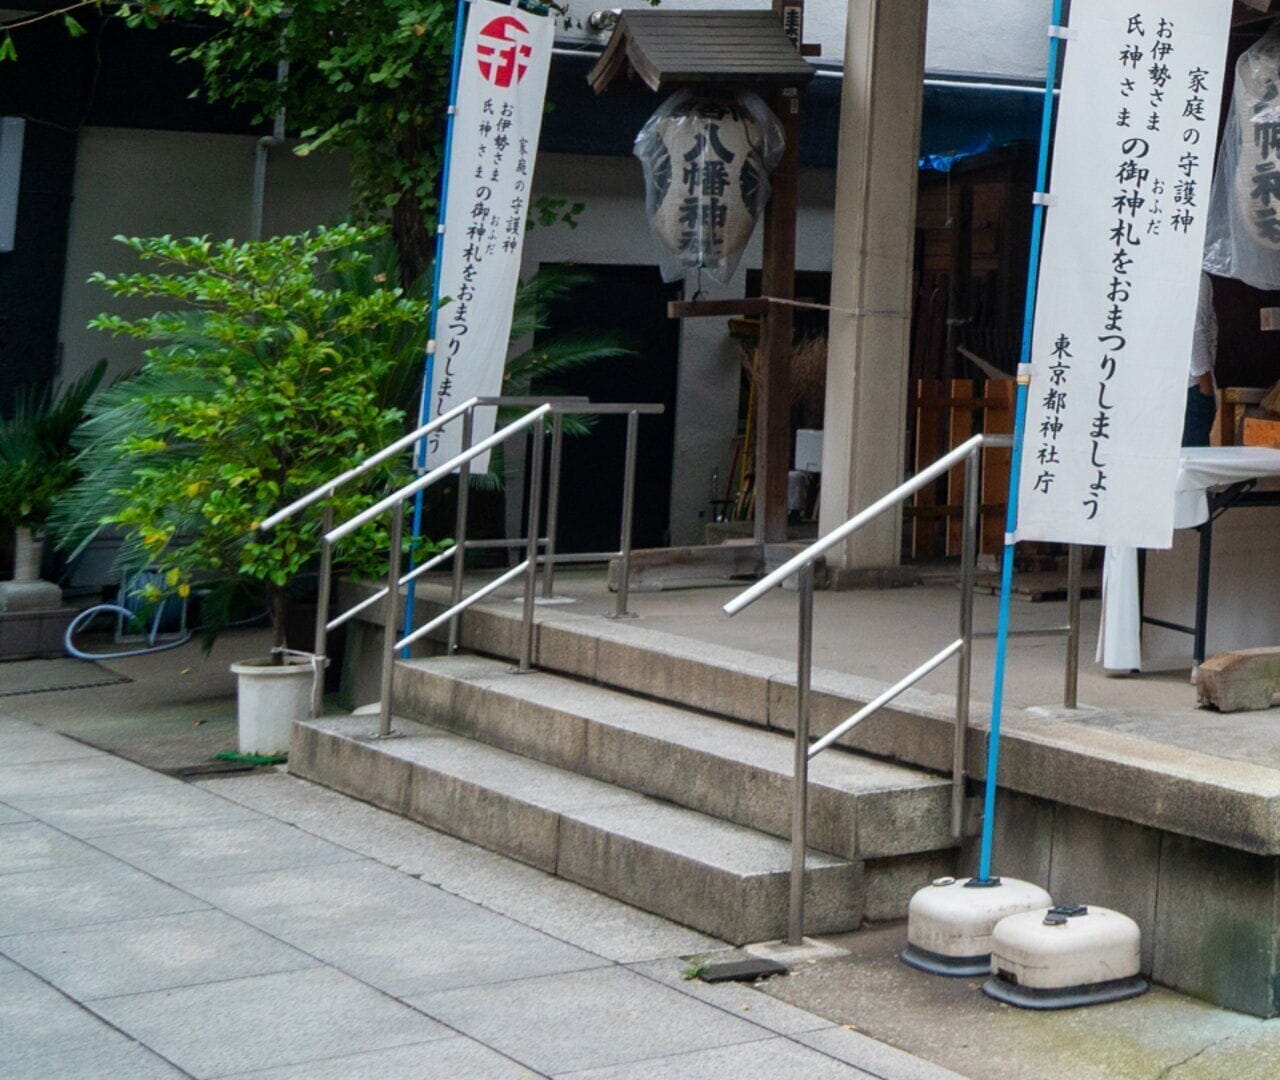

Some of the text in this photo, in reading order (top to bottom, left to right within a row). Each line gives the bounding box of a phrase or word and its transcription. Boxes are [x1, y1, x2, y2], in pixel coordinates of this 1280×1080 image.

[1116, 13, 1145, 128] 氏神さま
[1146, 17, 1174, 132] お伊勢さま
[474, 99, 494, 179] 氏神さま
[490, 102, 514, 183] お伊勢さま
[1170, 67, 1209, 235] 家庭の守護神
[502, 138, 529, 256] 家庭の守護神
[1146, 178, 1165, 236] おふだ
[1033, 333, 1074, 494] 東京都神社庁
